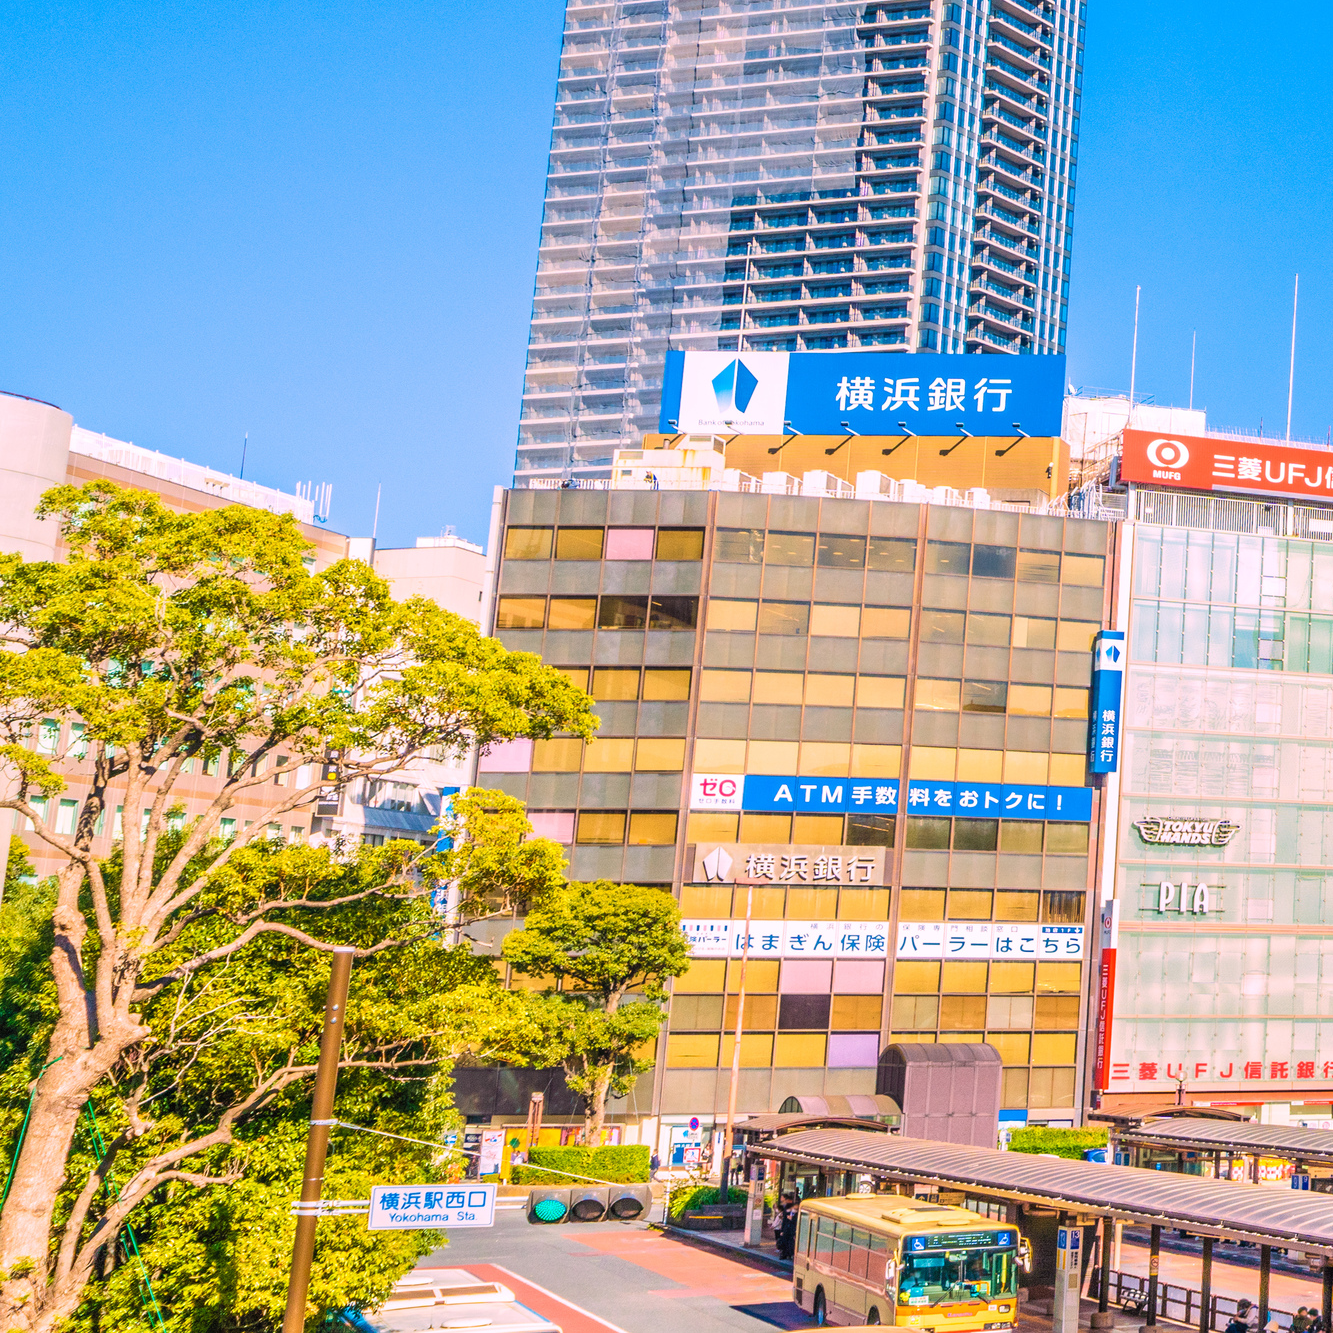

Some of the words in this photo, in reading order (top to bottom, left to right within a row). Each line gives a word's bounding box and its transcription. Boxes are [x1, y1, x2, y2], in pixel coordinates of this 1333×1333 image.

[835, 376, 1012, 412] 横浜銀行
[1153, 470, 1181, 481] MUFG
[1100, 709, 1116, 762] 横浜銀行
[1164, 821, 1214, 833] TOKYU
[1160, 832, 1211, 844] HANDS
[746, 854, 877, 882] 横浜銀行
[1159, 882, 1209, 912] PIA
[736, 933, 1081, 954] はまぎん保険パーラーはこちら
[380, 1191, 487, 1211] 横浜駅西口
[389, 1213, 449, 1222] Yokohama
[457, 1211, 478, 1221] Sta.
[1072, 1230, 1080, 1238] 13
